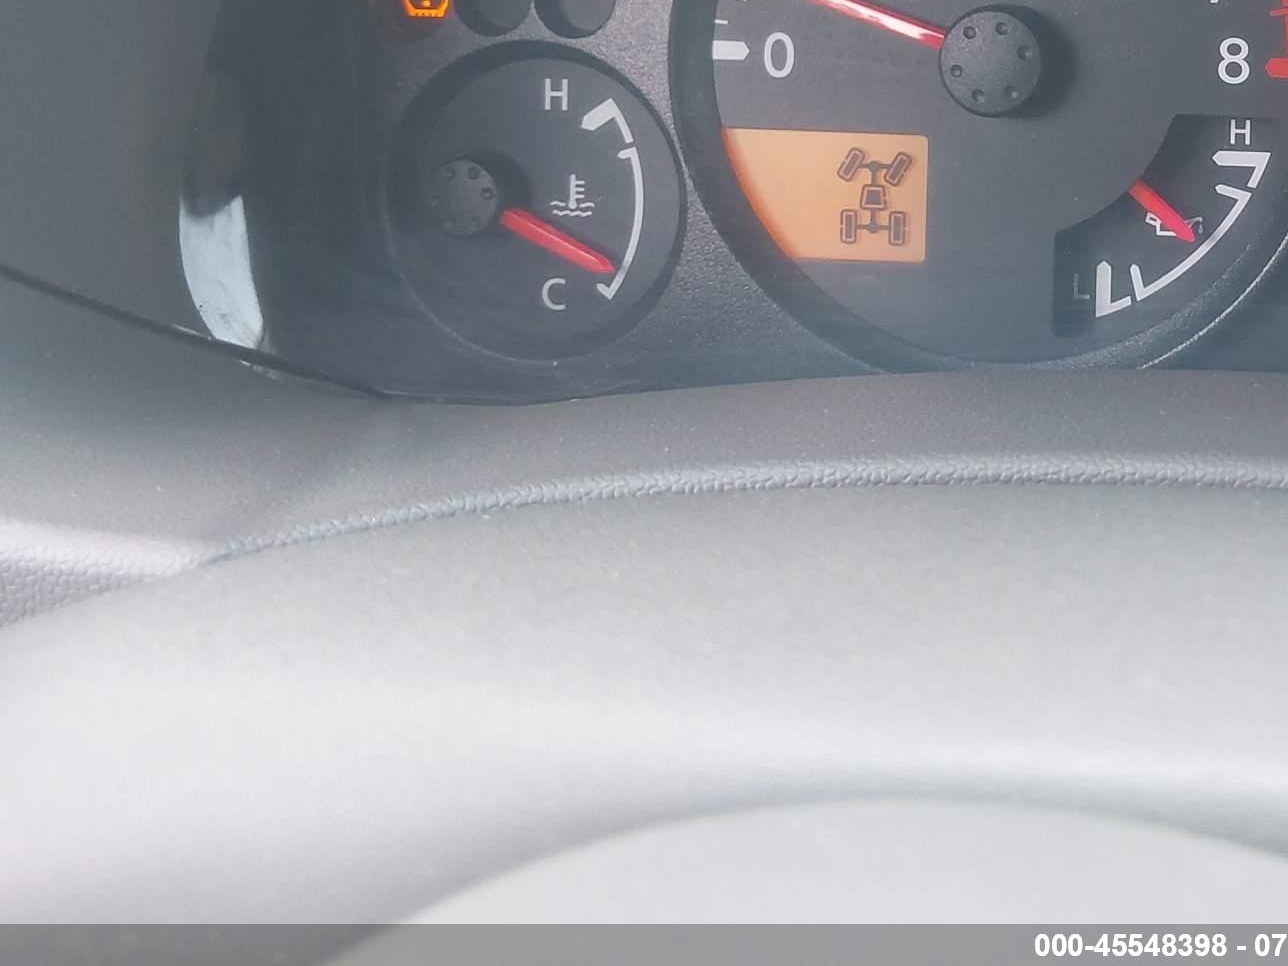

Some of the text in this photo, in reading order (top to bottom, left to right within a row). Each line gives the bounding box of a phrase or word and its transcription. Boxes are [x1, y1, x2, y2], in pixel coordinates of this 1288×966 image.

[763, 31, 795, 78] 0
[1217, 37, 1250, 84] 8
[544, 78, 569, 111] H
[1229, 119, 1252, 145] H
[541, 277, 566, 311] C
